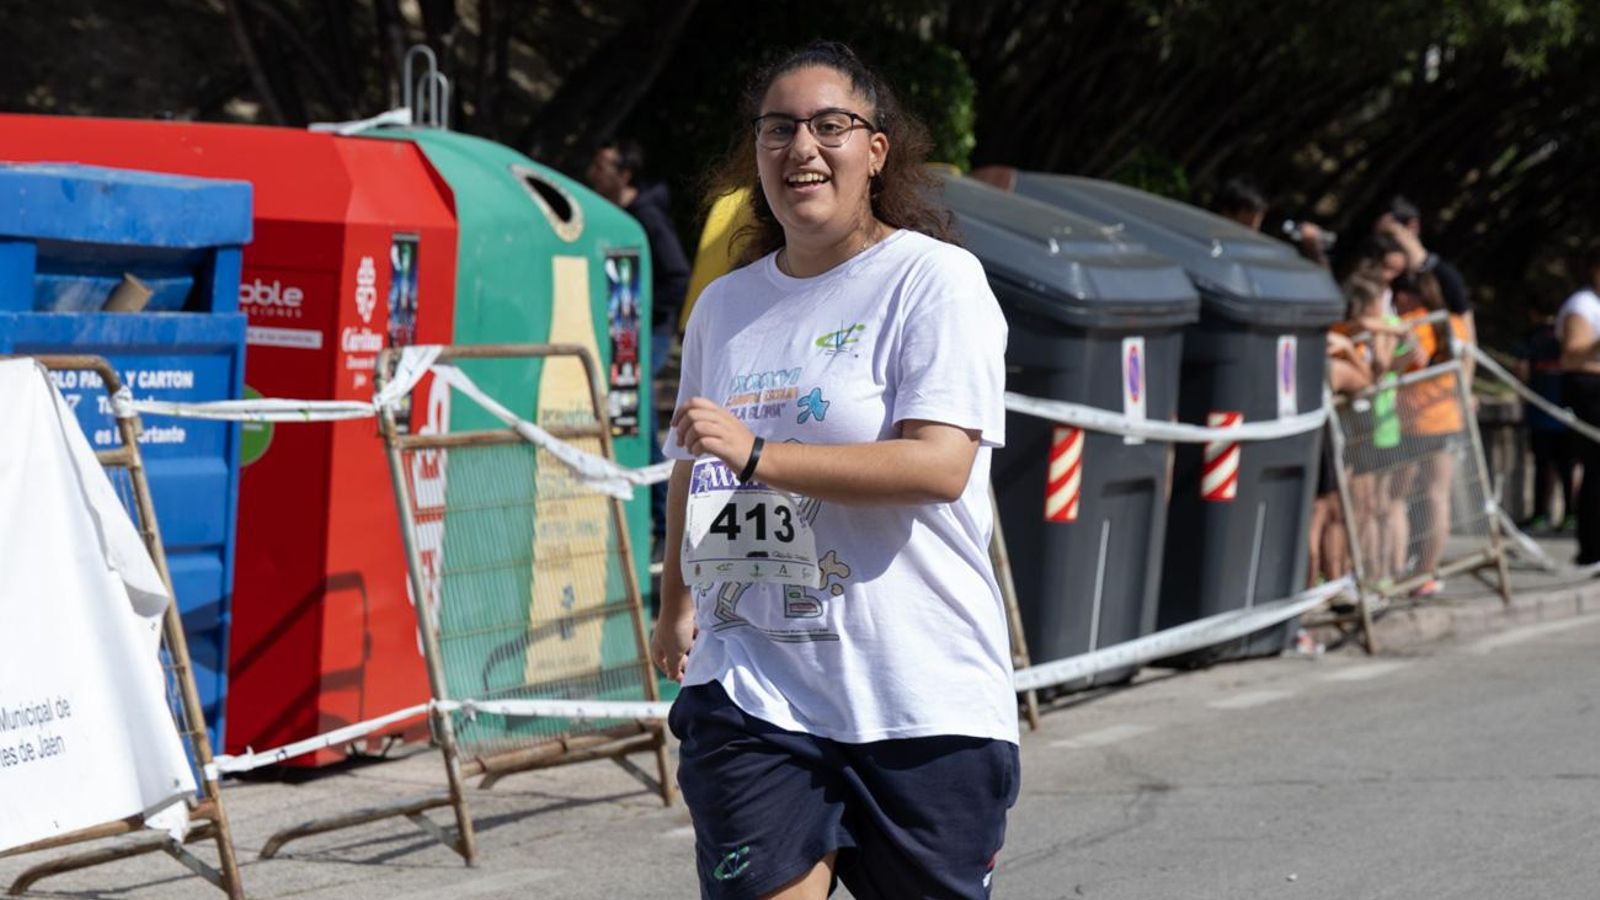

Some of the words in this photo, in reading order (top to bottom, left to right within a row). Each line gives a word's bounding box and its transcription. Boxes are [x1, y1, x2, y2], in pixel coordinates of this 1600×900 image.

[46, 370, 77, 389] OLO
[125, 371, 136, 388] Y
[137, 370, 193, 389] CARTON
[94, 429, 113, 445] es
[710, 503, 795, 544] 413
[56, 695, 71, 719] de
[19, 739, 35, 762] de
